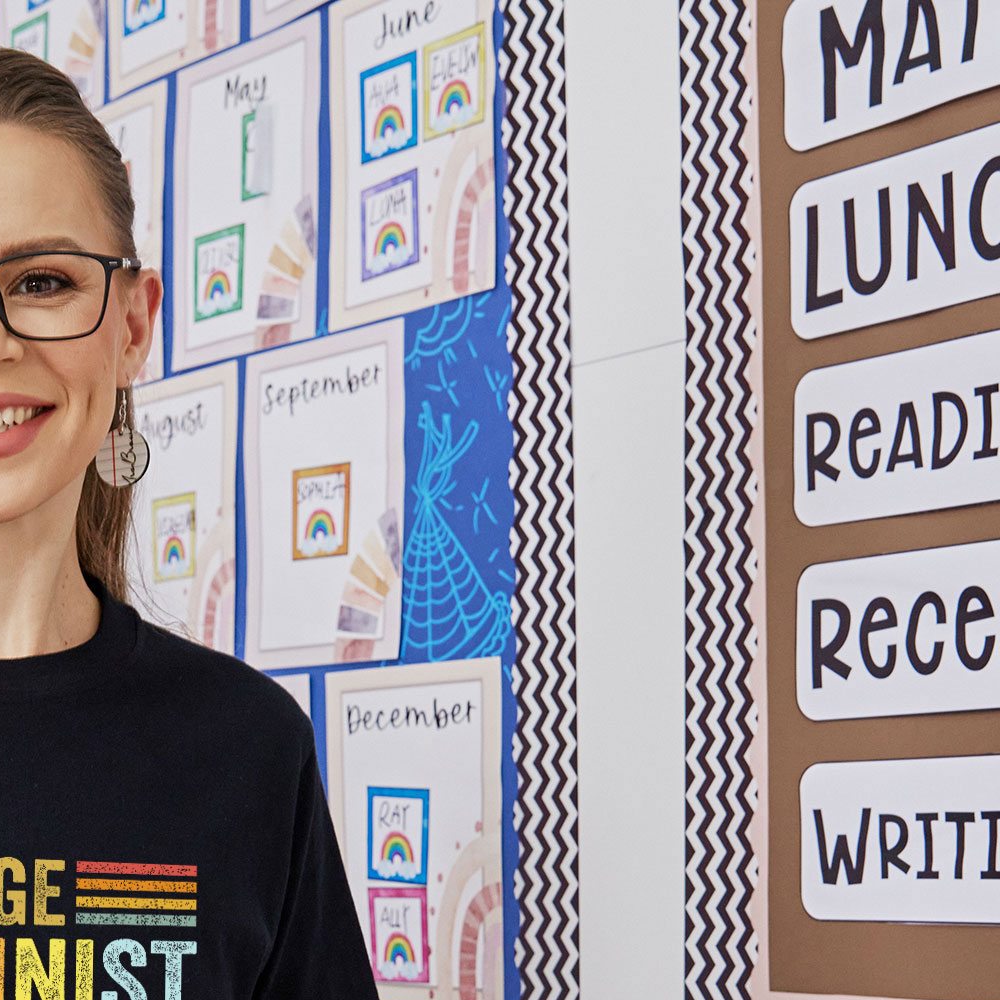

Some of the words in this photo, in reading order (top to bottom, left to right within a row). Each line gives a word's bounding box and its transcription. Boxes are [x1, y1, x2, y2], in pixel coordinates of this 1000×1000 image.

[374, 0, 442, 50] June
[224, 74, 267, 110] May
[263, 365, 383, 416] September
[141, 402, 207, 451] August
[347, 698, 477, 736] December
